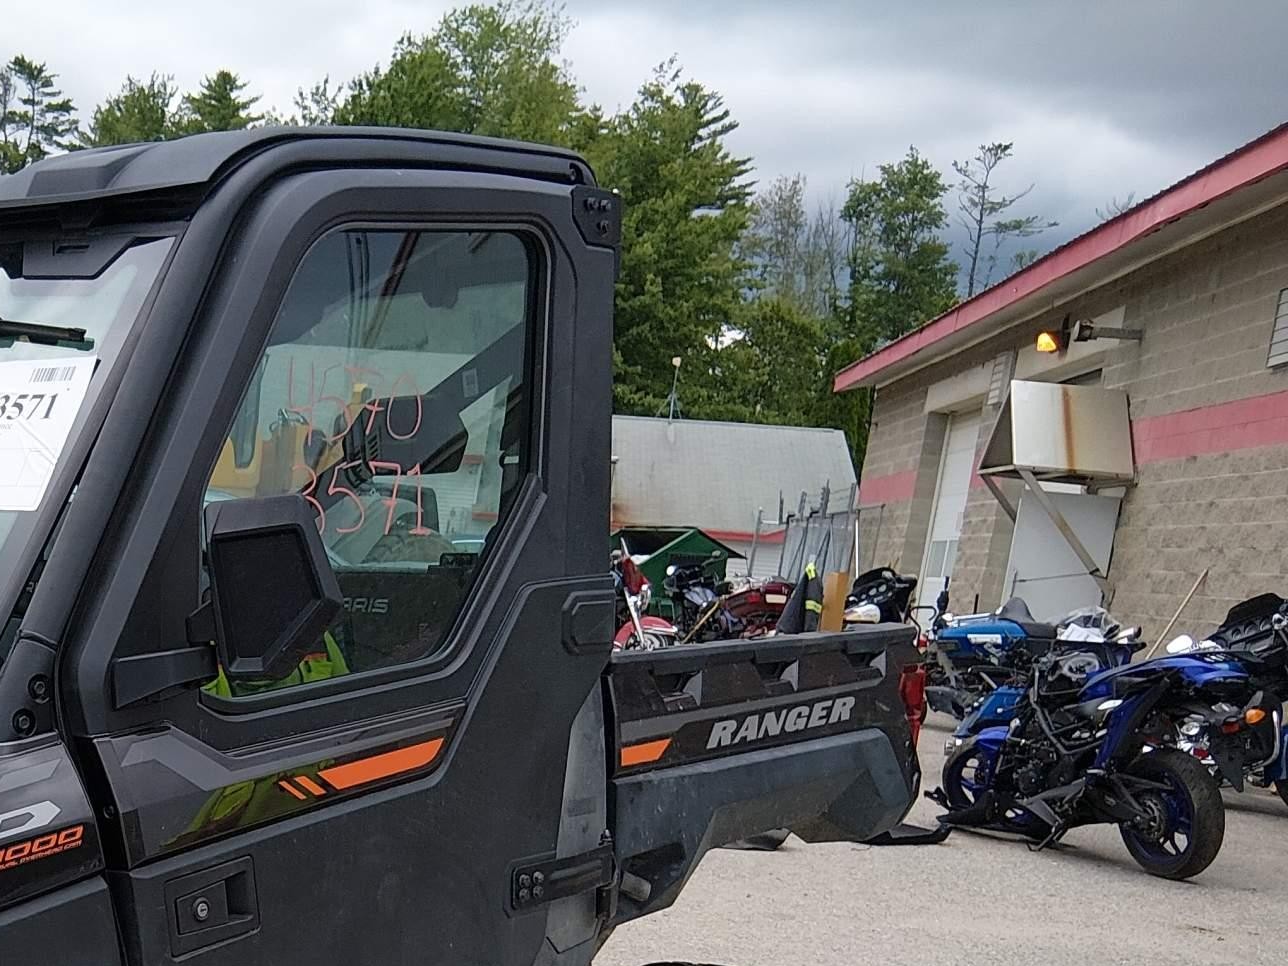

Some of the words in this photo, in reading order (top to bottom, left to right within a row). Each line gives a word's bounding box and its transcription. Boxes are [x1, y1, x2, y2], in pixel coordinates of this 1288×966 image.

[290, 460, 432, 535] 3571
[343, 597, 390, 614] ARIS
[706, 696, 856, 750] RANGER
